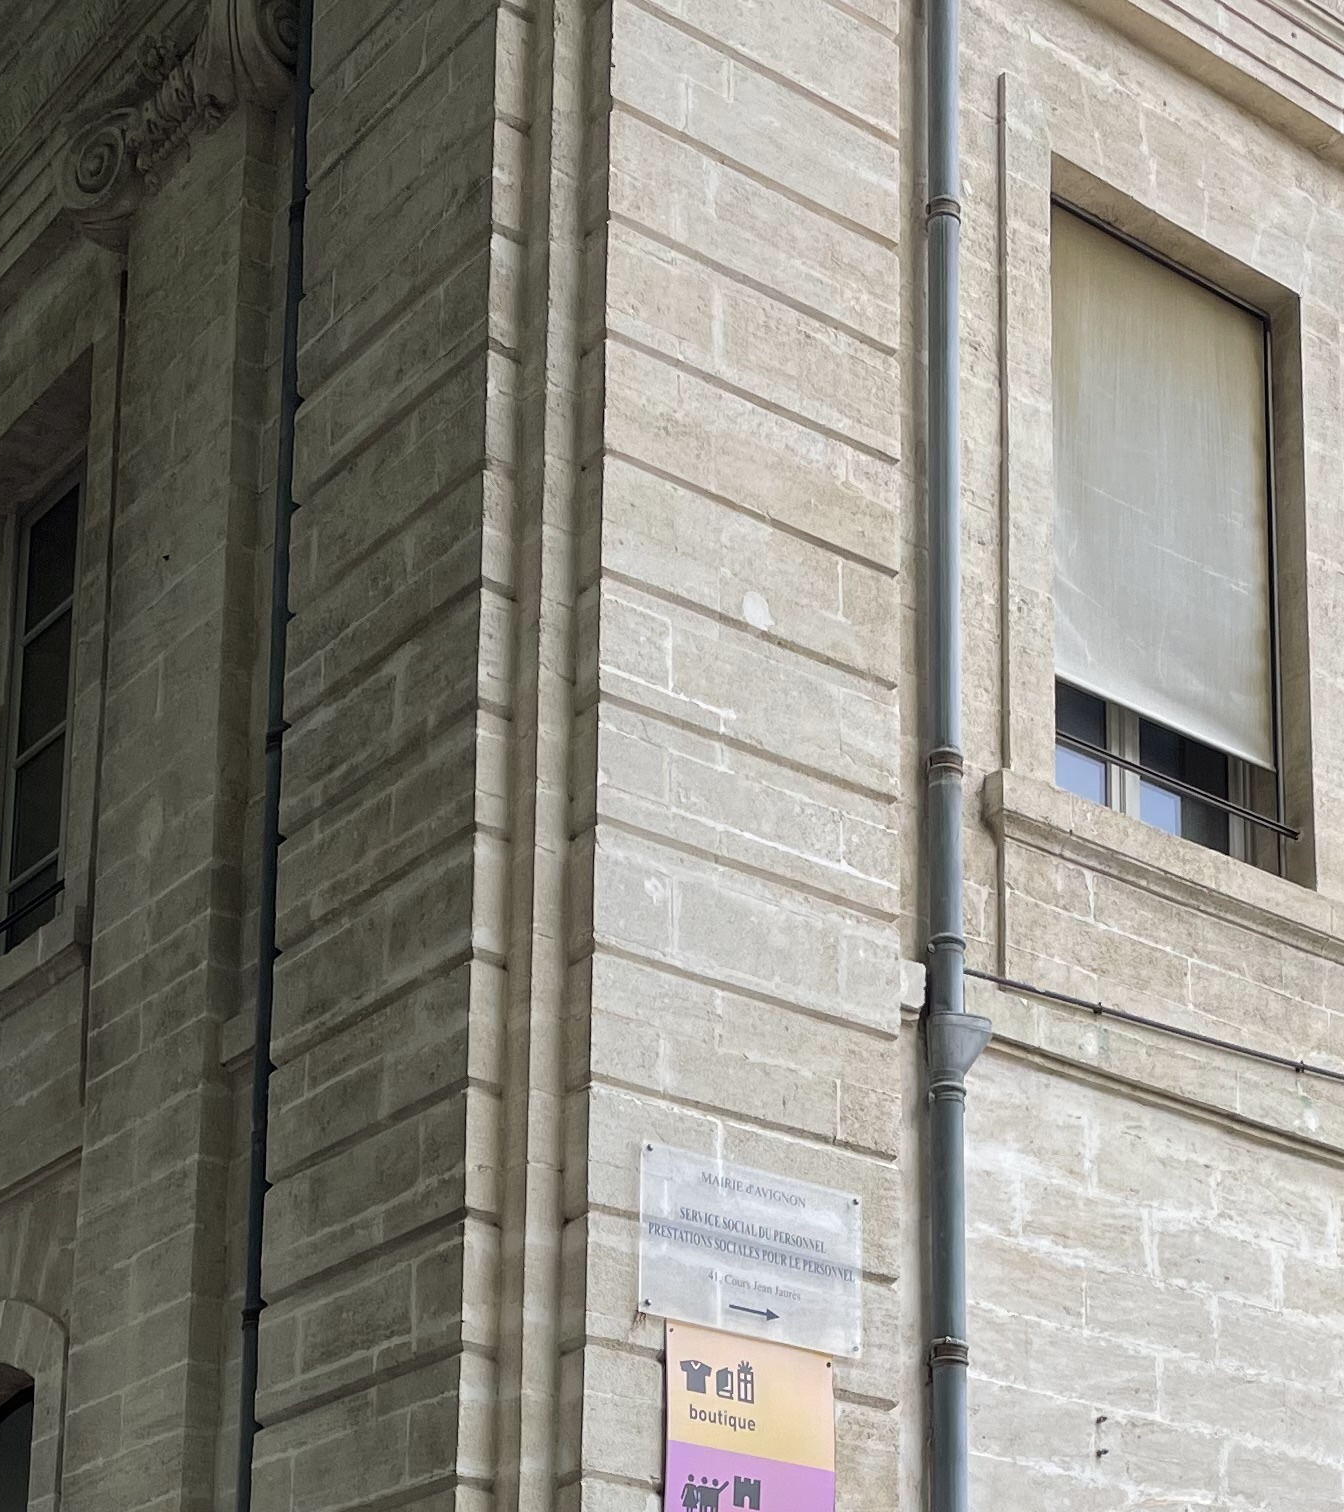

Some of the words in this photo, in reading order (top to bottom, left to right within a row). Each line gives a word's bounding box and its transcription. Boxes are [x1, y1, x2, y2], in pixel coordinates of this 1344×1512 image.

[701, 1171, 743, 1193] MAIRIE
[680, 1207, 721, 1229] SERVICE
[722, 1217, 757, 1238] SOCIAL
[758, 1226, 771, 1241] DU
[773, 1229, 827, 1254] PERSONNEL
[648, 1221, 713, 1248] PRESTATIONS
[714, 1239, 760, 1260] SOCIALES
[762, 1249, 787, 1266] POUR
[789, 1255, 801, 1271] LE
[803, 1259, 856, 1283] PERSONNEL
[724, 1274, 751, 1290] Cours
[752, 1280, 773, 1295] Jean
[689, 1404, 756, 1432] boutique
